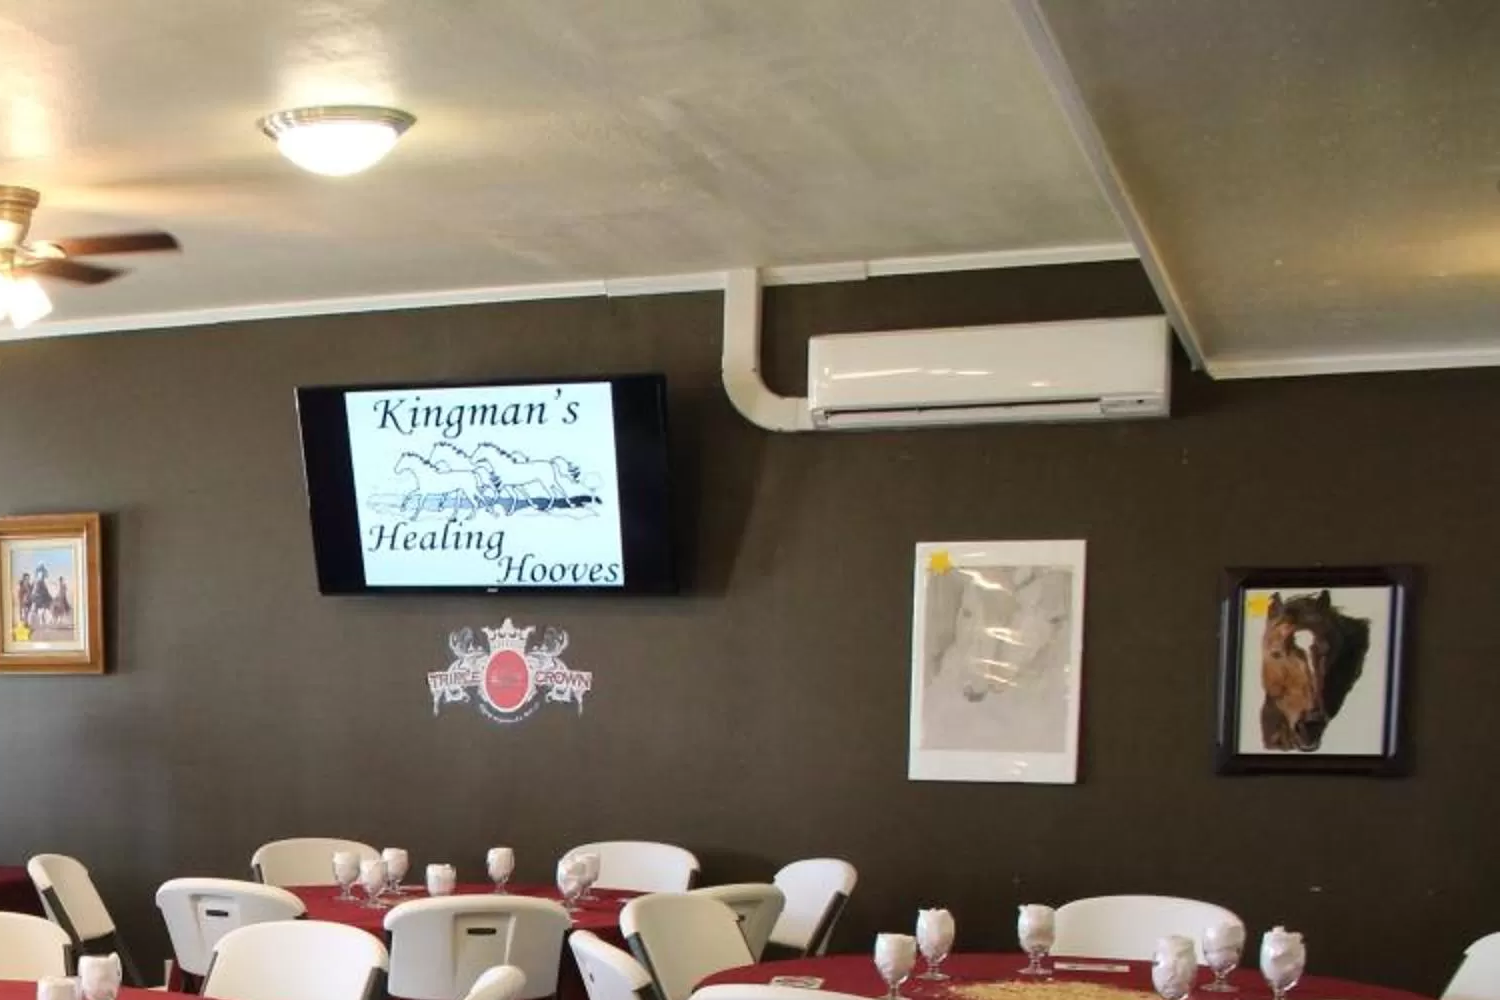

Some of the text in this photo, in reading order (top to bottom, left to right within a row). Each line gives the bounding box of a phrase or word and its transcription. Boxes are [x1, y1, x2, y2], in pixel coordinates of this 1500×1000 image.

[373, 387, 580, 438] Kingman's
[367, 519, 505, 560] Healing
[496, 553, 620, 584] Hooves
[535, 670, 591, 689] CROWN
